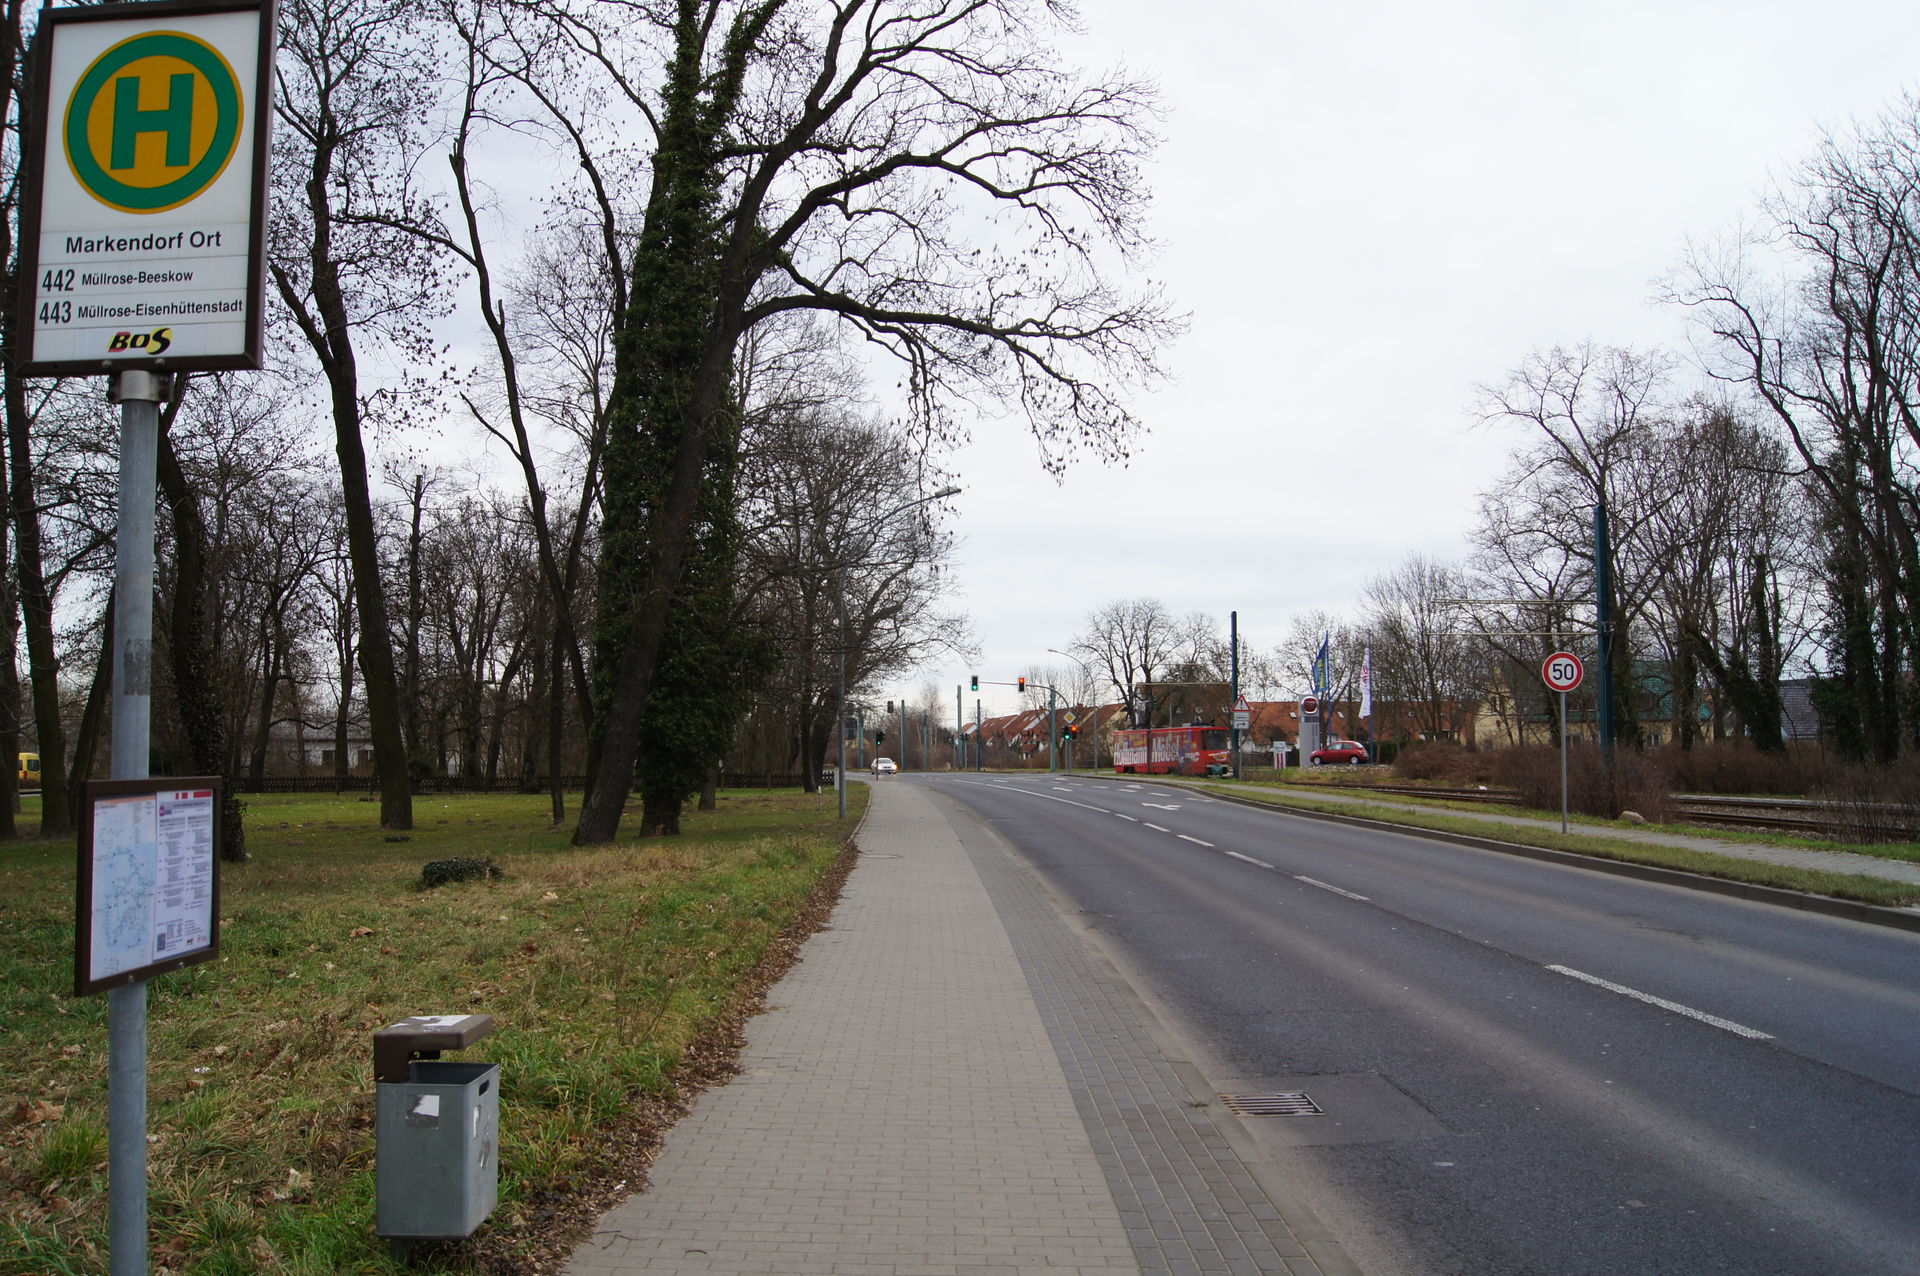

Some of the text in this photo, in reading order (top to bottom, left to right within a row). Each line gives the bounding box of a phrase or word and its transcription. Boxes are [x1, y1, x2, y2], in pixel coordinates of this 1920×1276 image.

[110, 73, 195, 170] H
[66, 230, 222, 253] Markendorf Ort
[42, 268, 193, 292] 442 Müllrose-Beeskow
[39, 299, 243, 325] 443 Müllrose-Eisenhüttenstadt
[1552, 663, 1574, 681] 50
